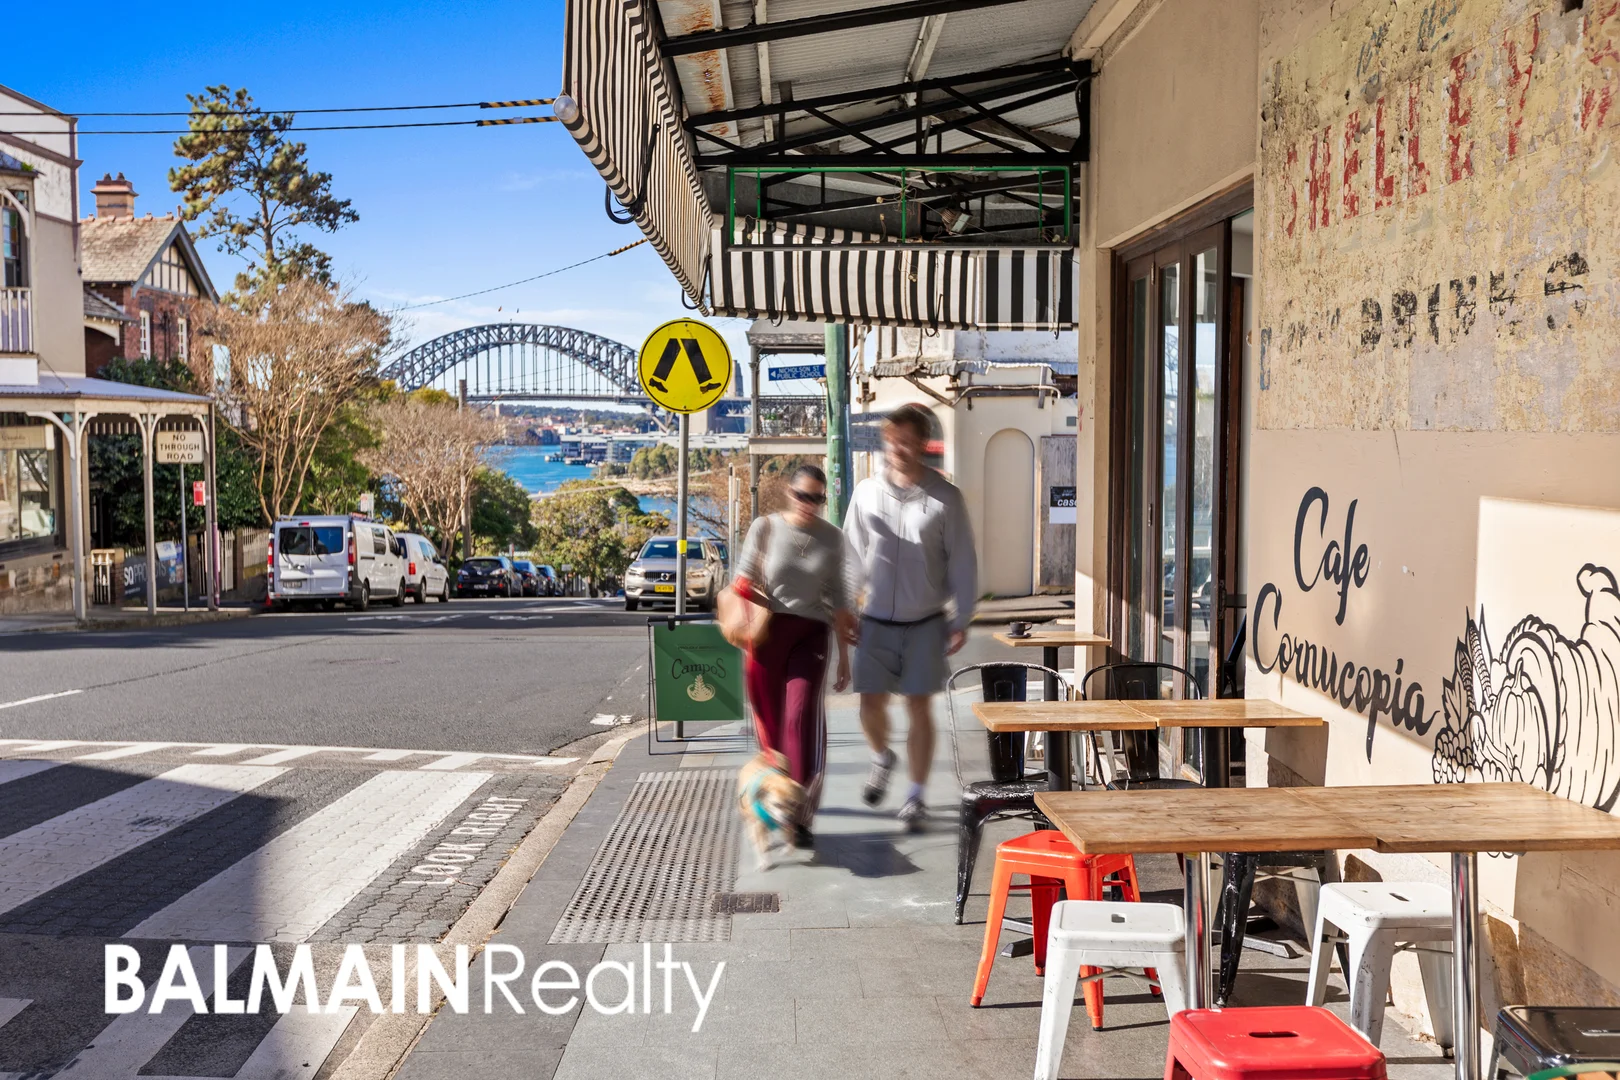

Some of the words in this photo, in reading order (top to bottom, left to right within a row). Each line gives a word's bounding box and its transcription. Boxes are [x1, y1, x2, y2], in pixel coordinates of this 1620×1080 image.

[800, 370, 822, 378] SCHOOL
[160, 443, 200, 451] THROUGH
[172, 433, 186, 441] NO
[1293, 486, 1371, 626] Cafe
[1252, 582, 1441, 765] Cornucopia
[401, 842, 487, 885] LOOK
[450, 796, 530, 835] RIGHT
